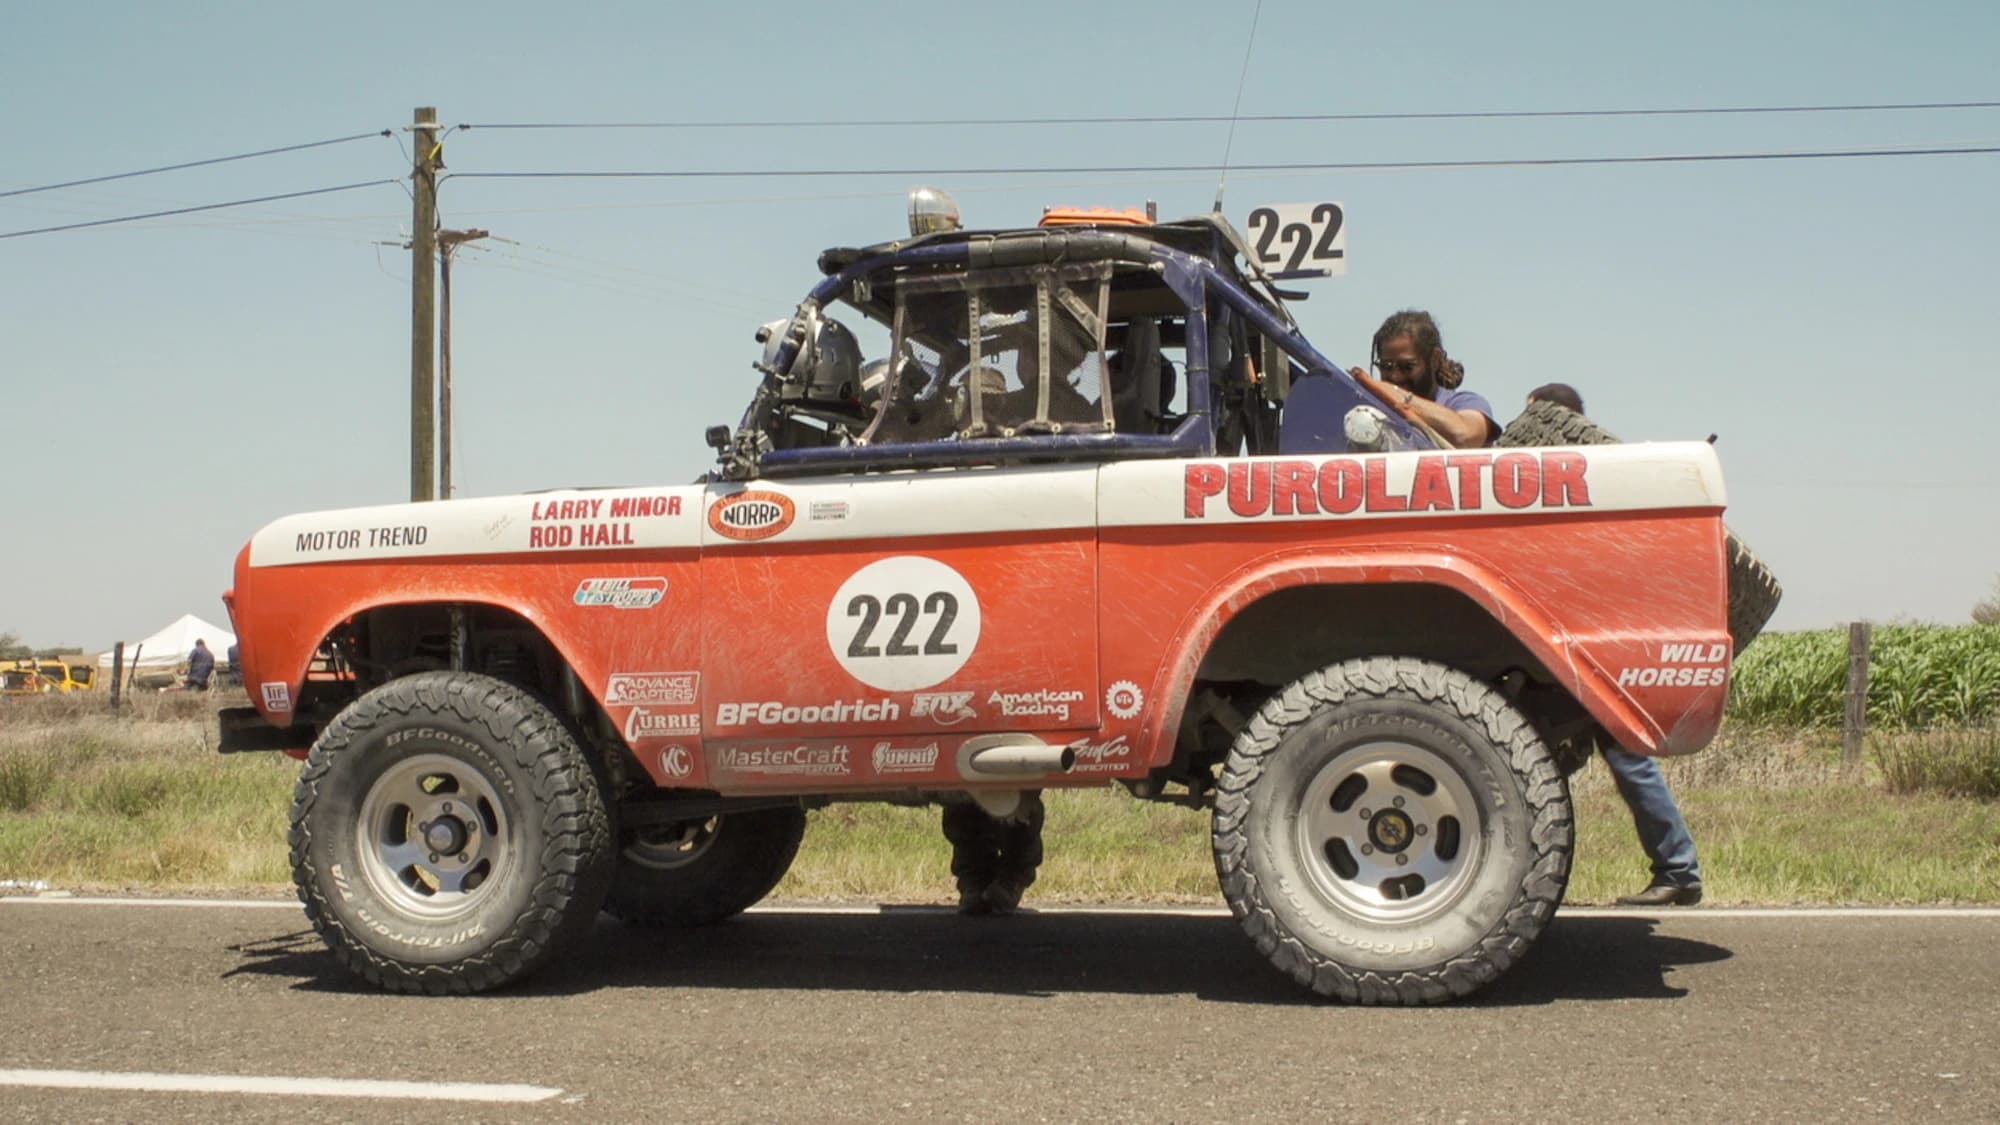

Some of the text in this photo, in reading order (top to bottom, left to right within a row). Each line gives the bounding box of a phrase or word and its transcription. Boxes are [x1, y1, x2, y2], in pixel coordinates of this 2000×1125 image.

[1248, 203, 1343, 272] 222
[1184, 451, 1592, 518] PUROLATOR
[531, 496, 682, 521] LARRY MINOR
[296, 525, 428, 551] MOTOR TREND
[529, 525, 573, 548] ROD
[579, 522, 634, 547] HALL
[846, 591, 959, 658] 222
[1660, 643, 1727, 663] WILD
[625, 676, 693, 690] ADVANCE
[1617, 667, 1726, 687] HORSES
[619, 688, 694, 701] ADAPTERS
[987, 687, 1084, 705] American
[716, 698, 900, 726] BFGoodrich
[1002, 701, 1069, 721] Racing
[385, 727, 515, 795] BFGoodrich
[718, 744, 850, 767] MasterCraft
